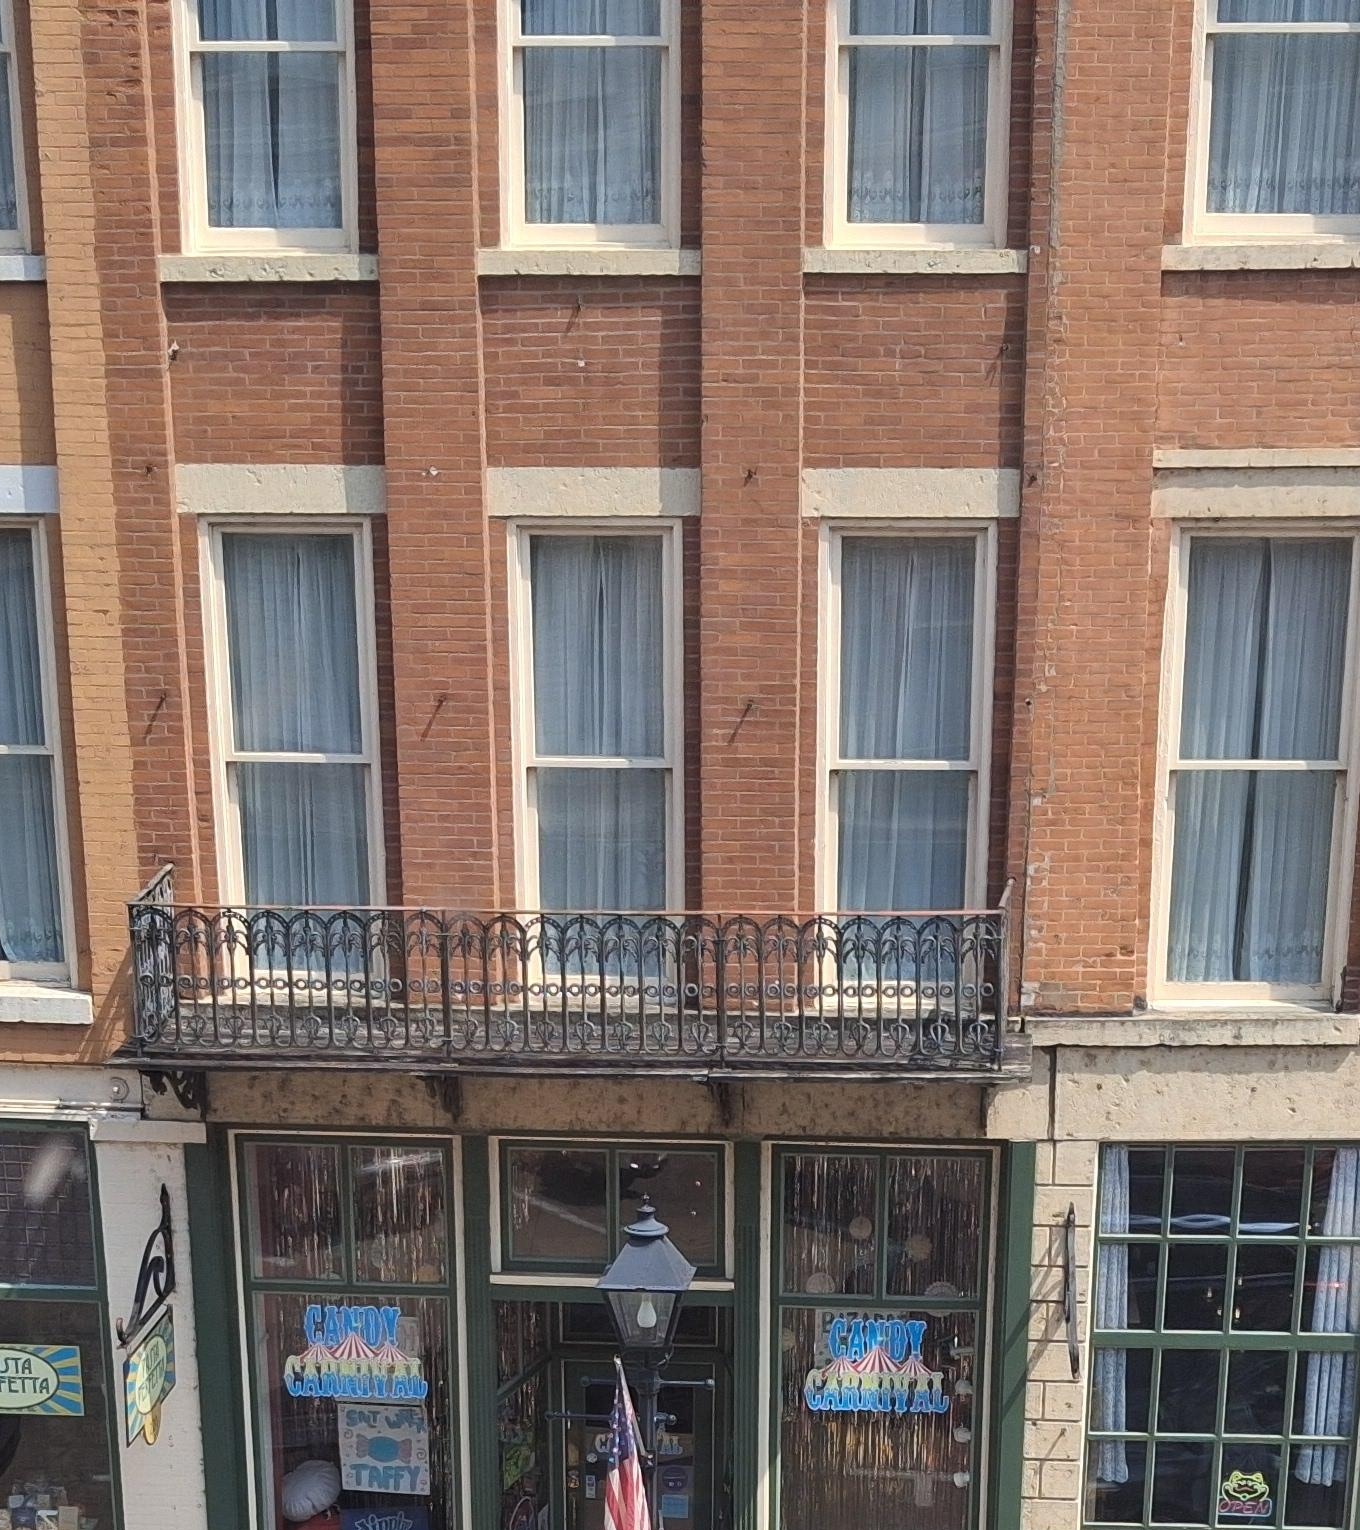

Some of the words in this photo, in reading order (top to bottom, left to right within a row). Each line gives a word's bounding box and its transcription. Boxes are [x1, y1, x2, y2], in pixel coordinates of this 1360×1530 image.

[303, 1304, 401, 1349] CANDY
[828, 1318, 928, 1362] CANDY
[284, 1355, 429, 1399] CARNIVAL
[804, 1369, 951, 1414] CARNIVAL
[349, 1463, 421, 1492] TAFFY
[1219, 1500, 1269, 1514] OPEN
